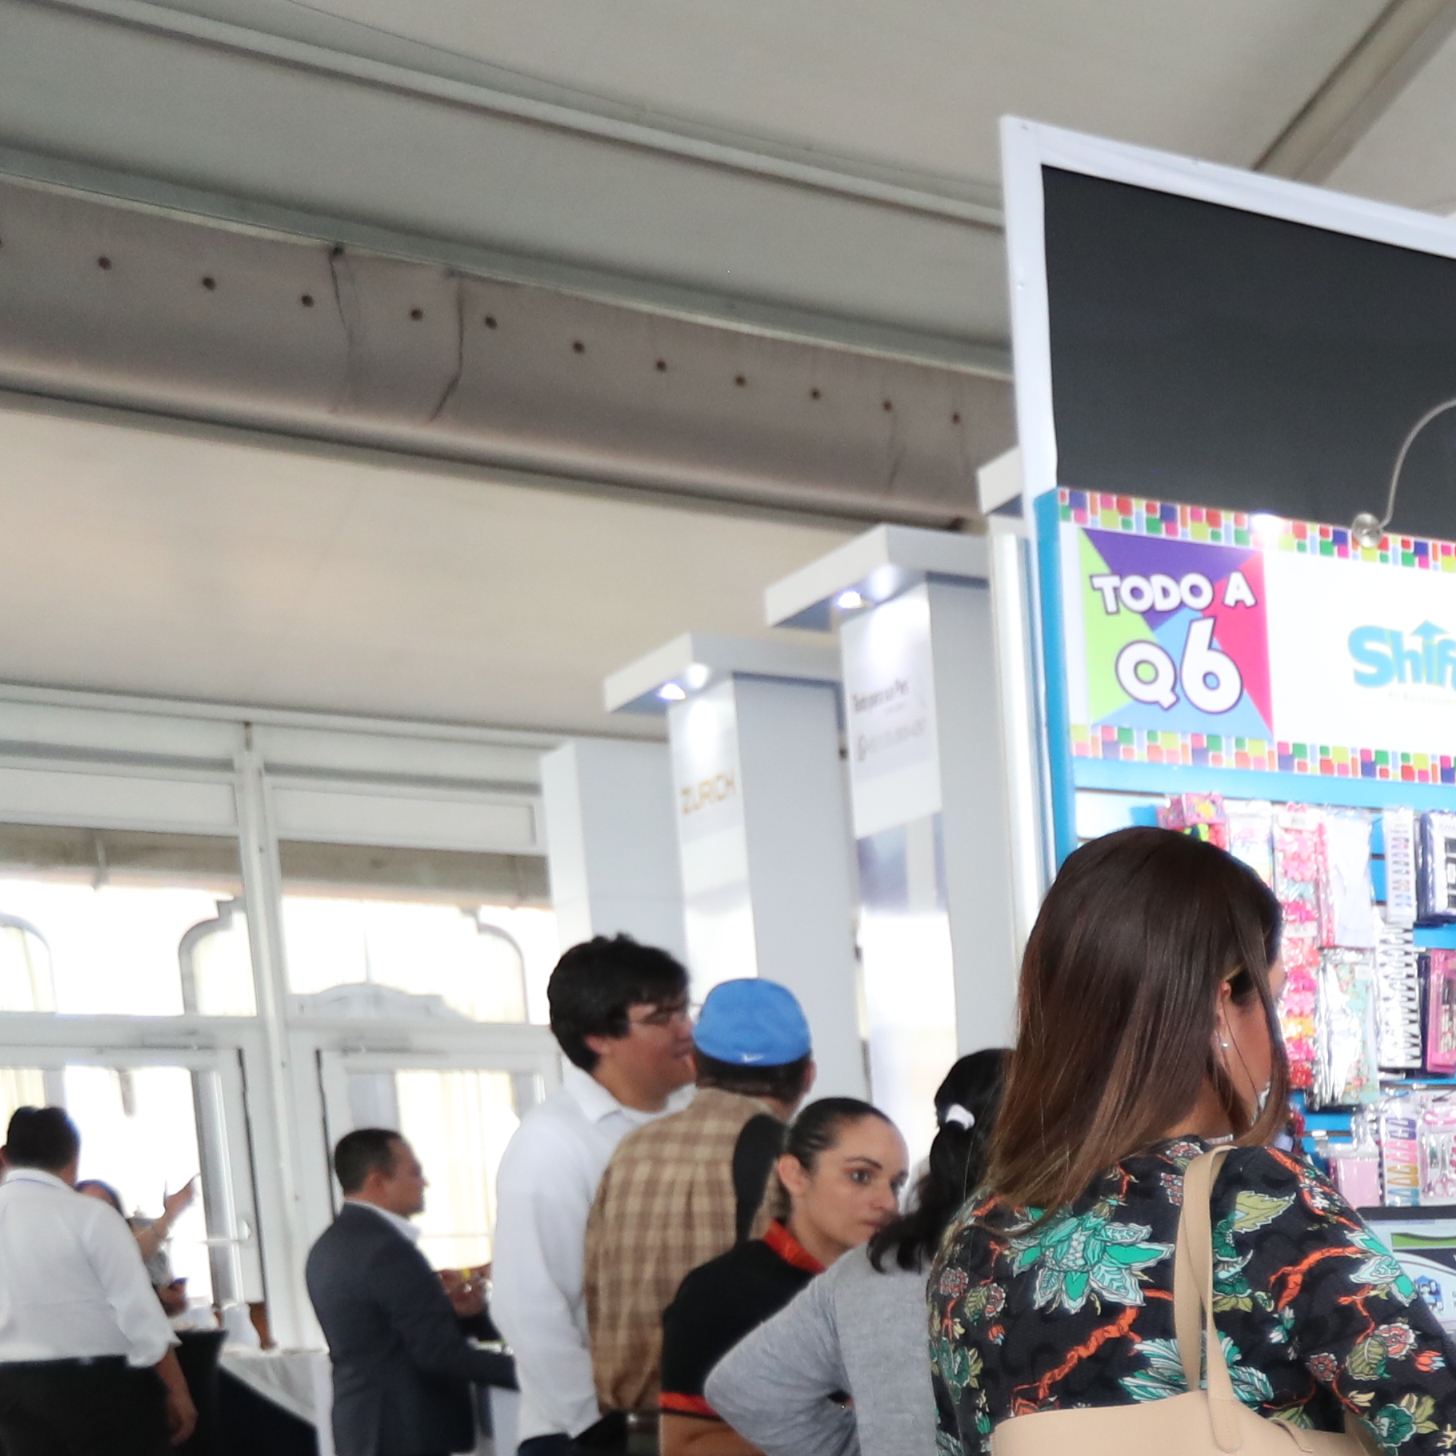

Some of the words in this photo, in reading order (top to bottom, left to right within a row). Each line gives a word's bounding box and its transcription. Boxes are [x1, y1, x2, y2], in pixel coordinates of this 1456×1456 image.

[1090, 572, 1214, 615] TODO
[1222, 571, 1257, 609] A
[1115, 616, 1244, 715] Q6
